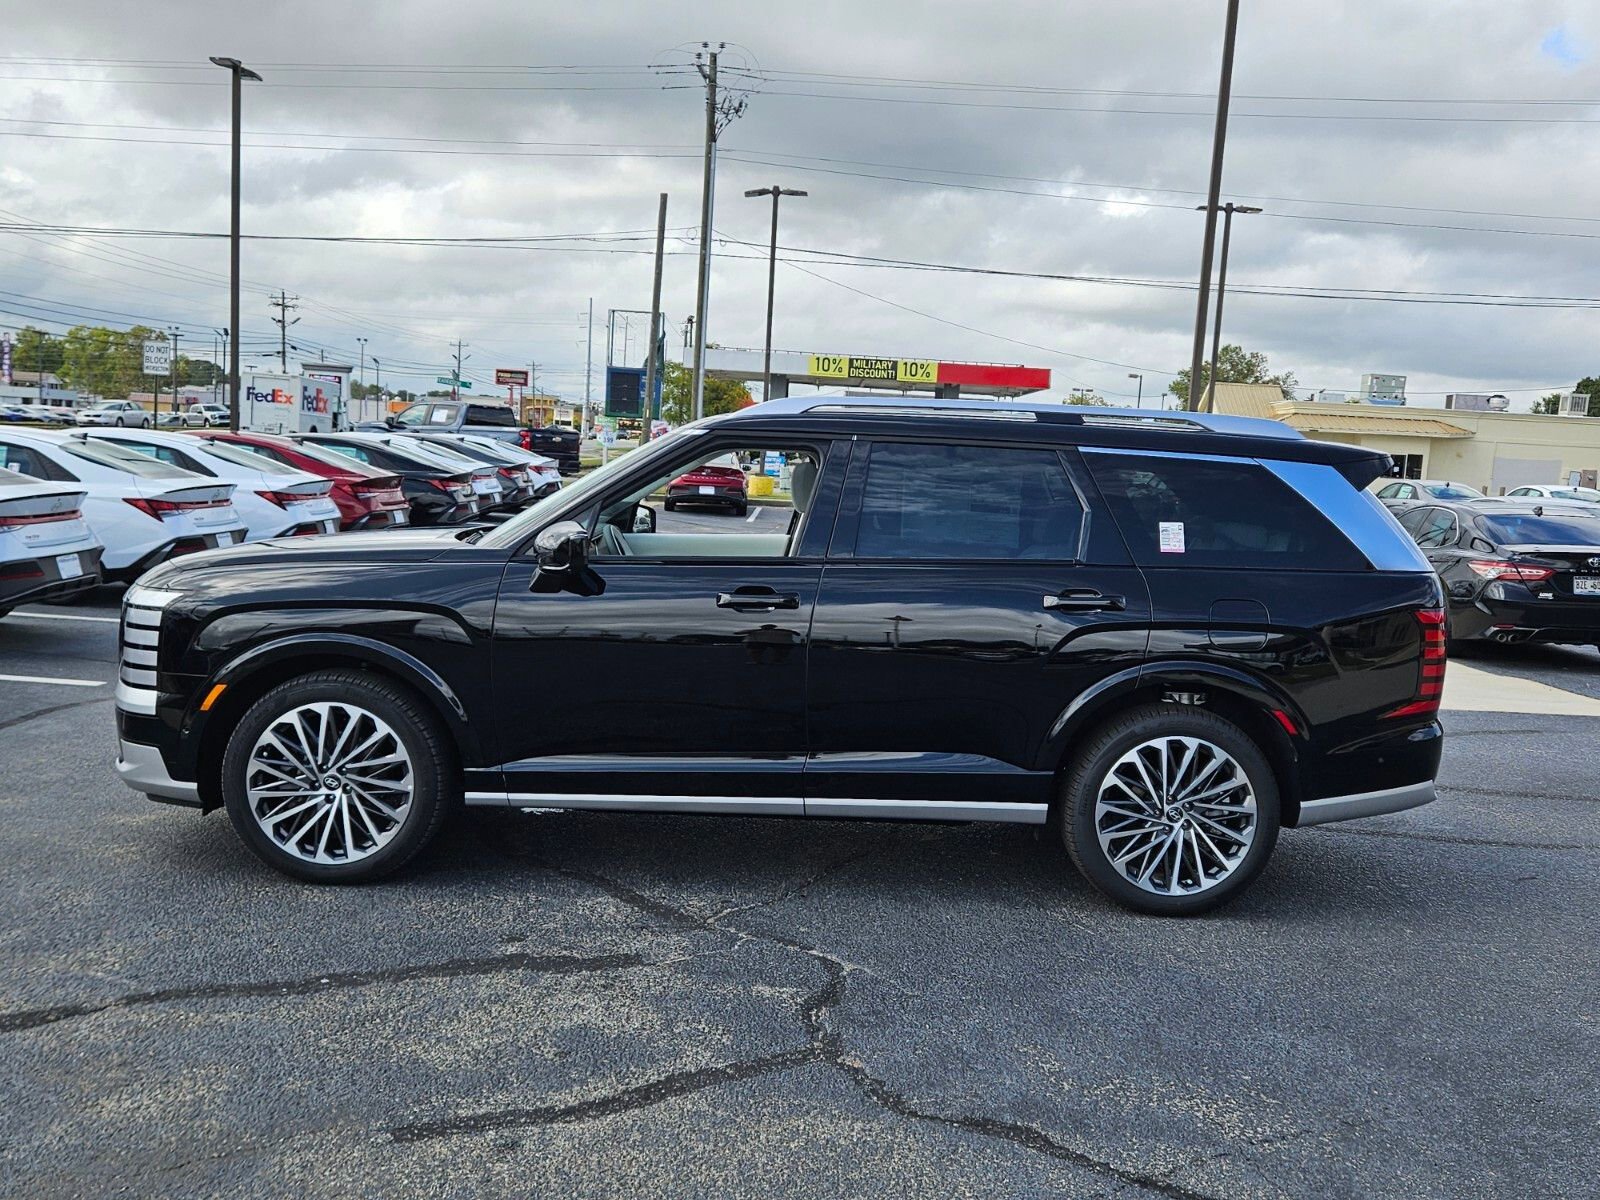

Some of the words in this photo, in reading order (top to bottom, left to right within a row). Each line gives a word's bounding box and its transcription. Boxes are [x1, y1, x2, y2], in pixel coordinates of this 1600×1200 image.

[145, 345, 154, 353] DO
[156, 346, 169, 354] NOT
[145, 355, 168, 365] BLOCK
[815, 356, 843, 373] 10%
[853, 359, 894, 369] MILITARY
[849, 369, 896, 379] DISCOUNT!
[902, 362, 931, 378] 10%
[246, 386, 294, 405] FedEx
[302, 385, 329, 414] FedEx
